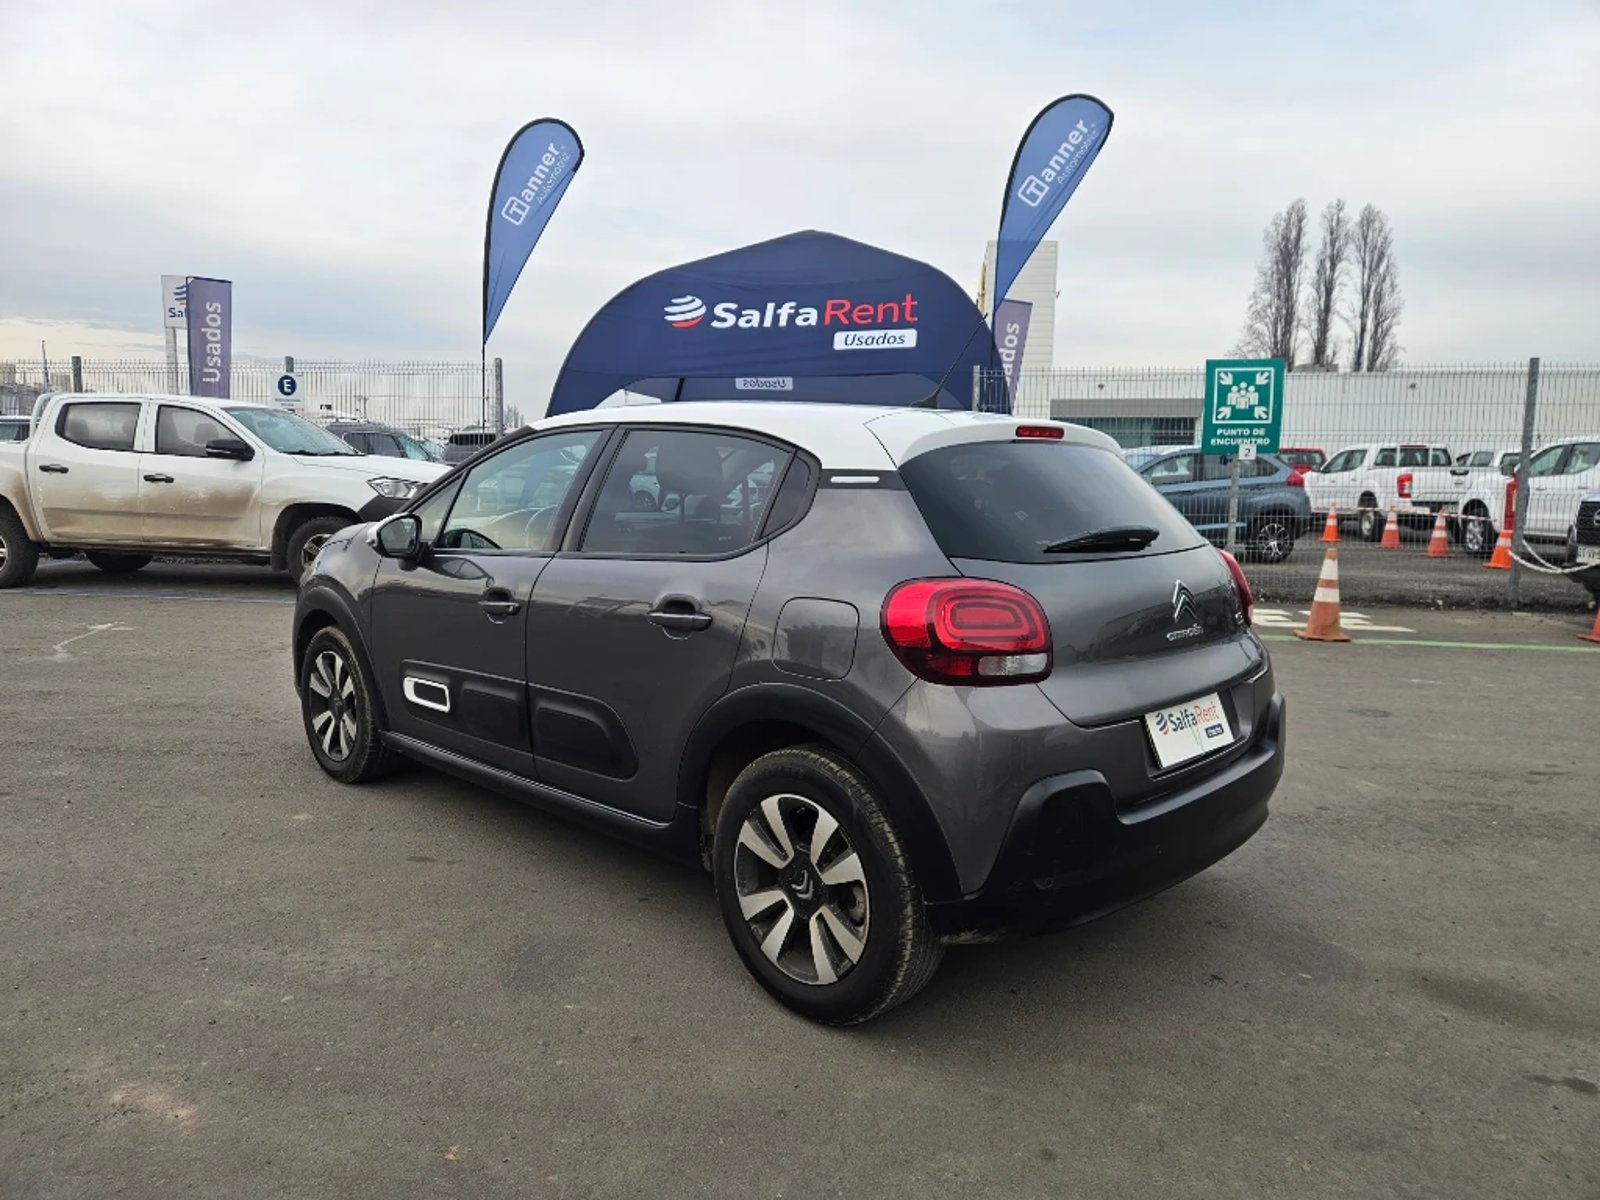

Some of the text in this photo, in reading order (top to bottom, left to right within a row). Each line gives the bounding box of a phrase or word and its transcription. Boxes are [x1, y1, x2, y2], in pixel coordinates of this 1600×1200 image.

[1018, 119, 1089, 207] Tanner
[501, 142, 560, 226] Tanner
[202, 302, 222, 383] Usados
[844, 331, 906, 347] Usados
[282, 379, 292, 393] E
[1216, 427, 1267, 436] PUNTO DE
[1210, 437, 1271, 446] ENCUENTRO
[1243, 447, 1251, 457] 2
[1167, 701, 1220, 733] SalfaRent
